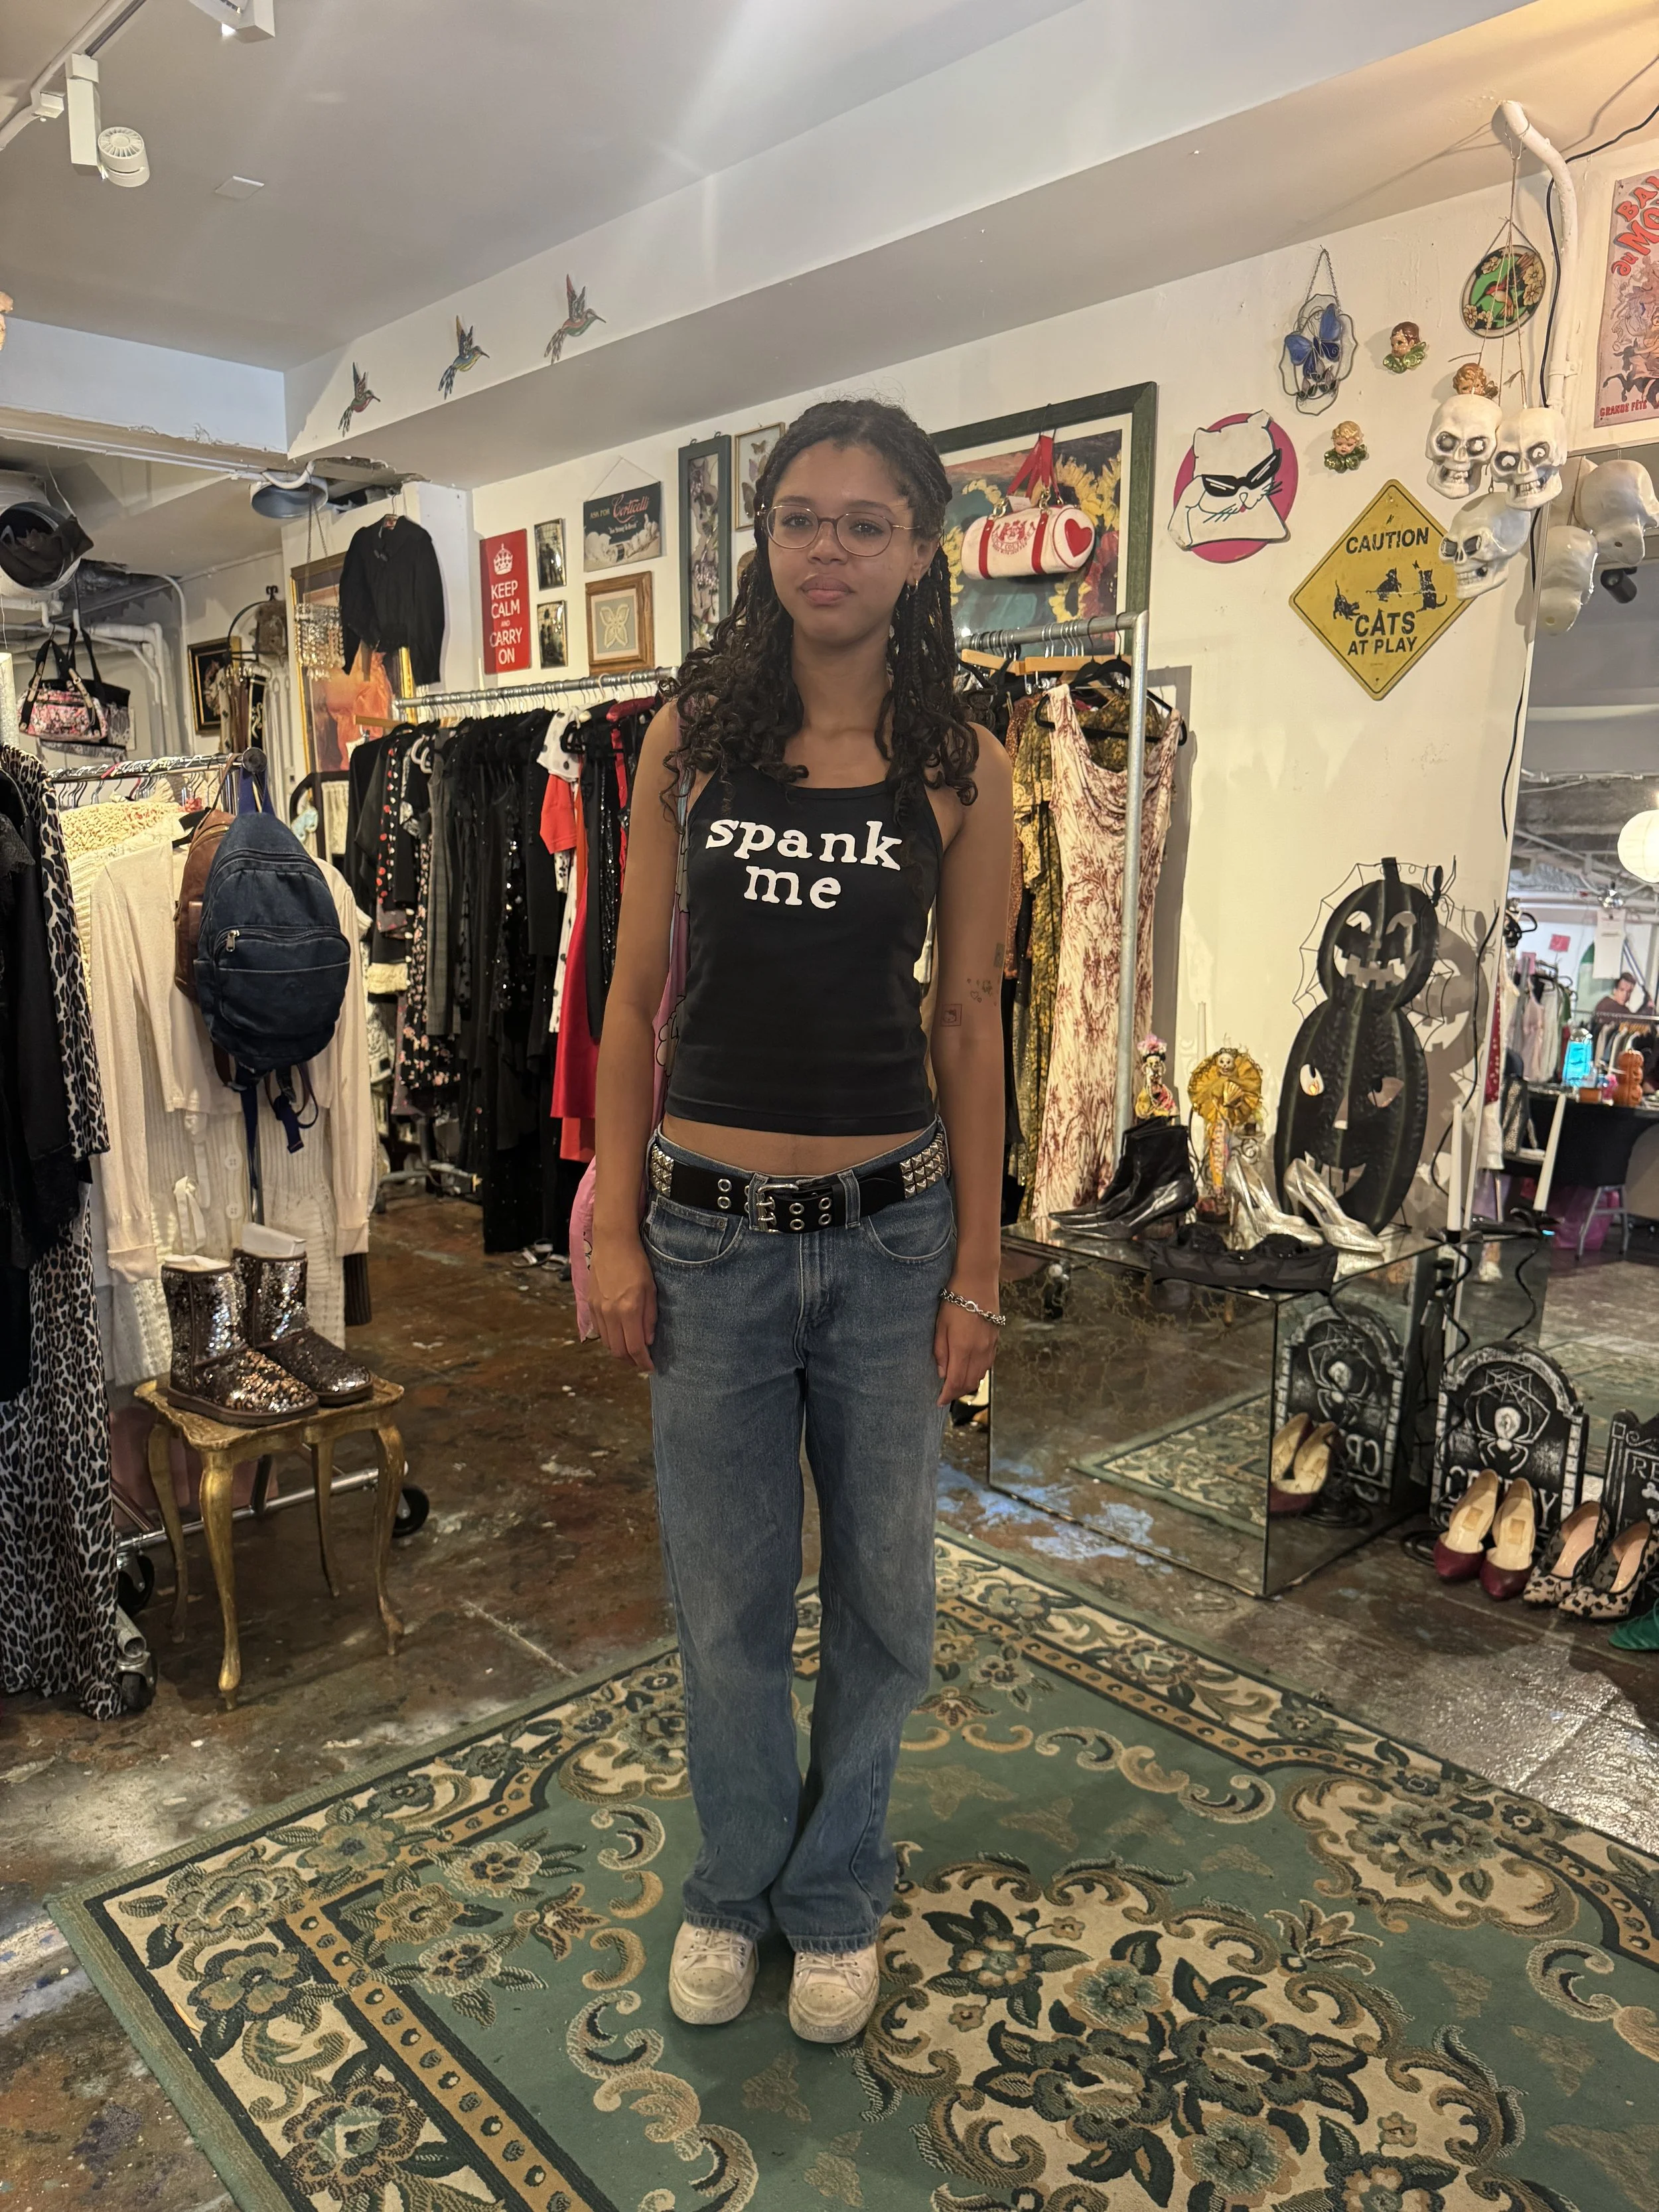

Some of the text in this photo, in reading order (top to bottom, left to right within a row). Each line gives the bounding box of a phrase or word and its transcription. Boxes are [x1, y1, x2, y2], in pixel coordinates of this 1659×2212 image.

[1615, 199, 1659, 256] MO
[1599, 403, 1629, 417] GRANDE
[1345, 527, 1429, 554] CAUTION
[491, 580, 518, 600] KEEP
[491, 598, 520, 619] CALM
[1354, 611, 1415, 637] CATS
[490, 627, 522, 648] CARRY
[1347, 636, 1418, 656] AT PLAY
[498, 647, 515, 665] ON
[705, 819, 902, 871] spank
[744, 865, 841, 909] me
